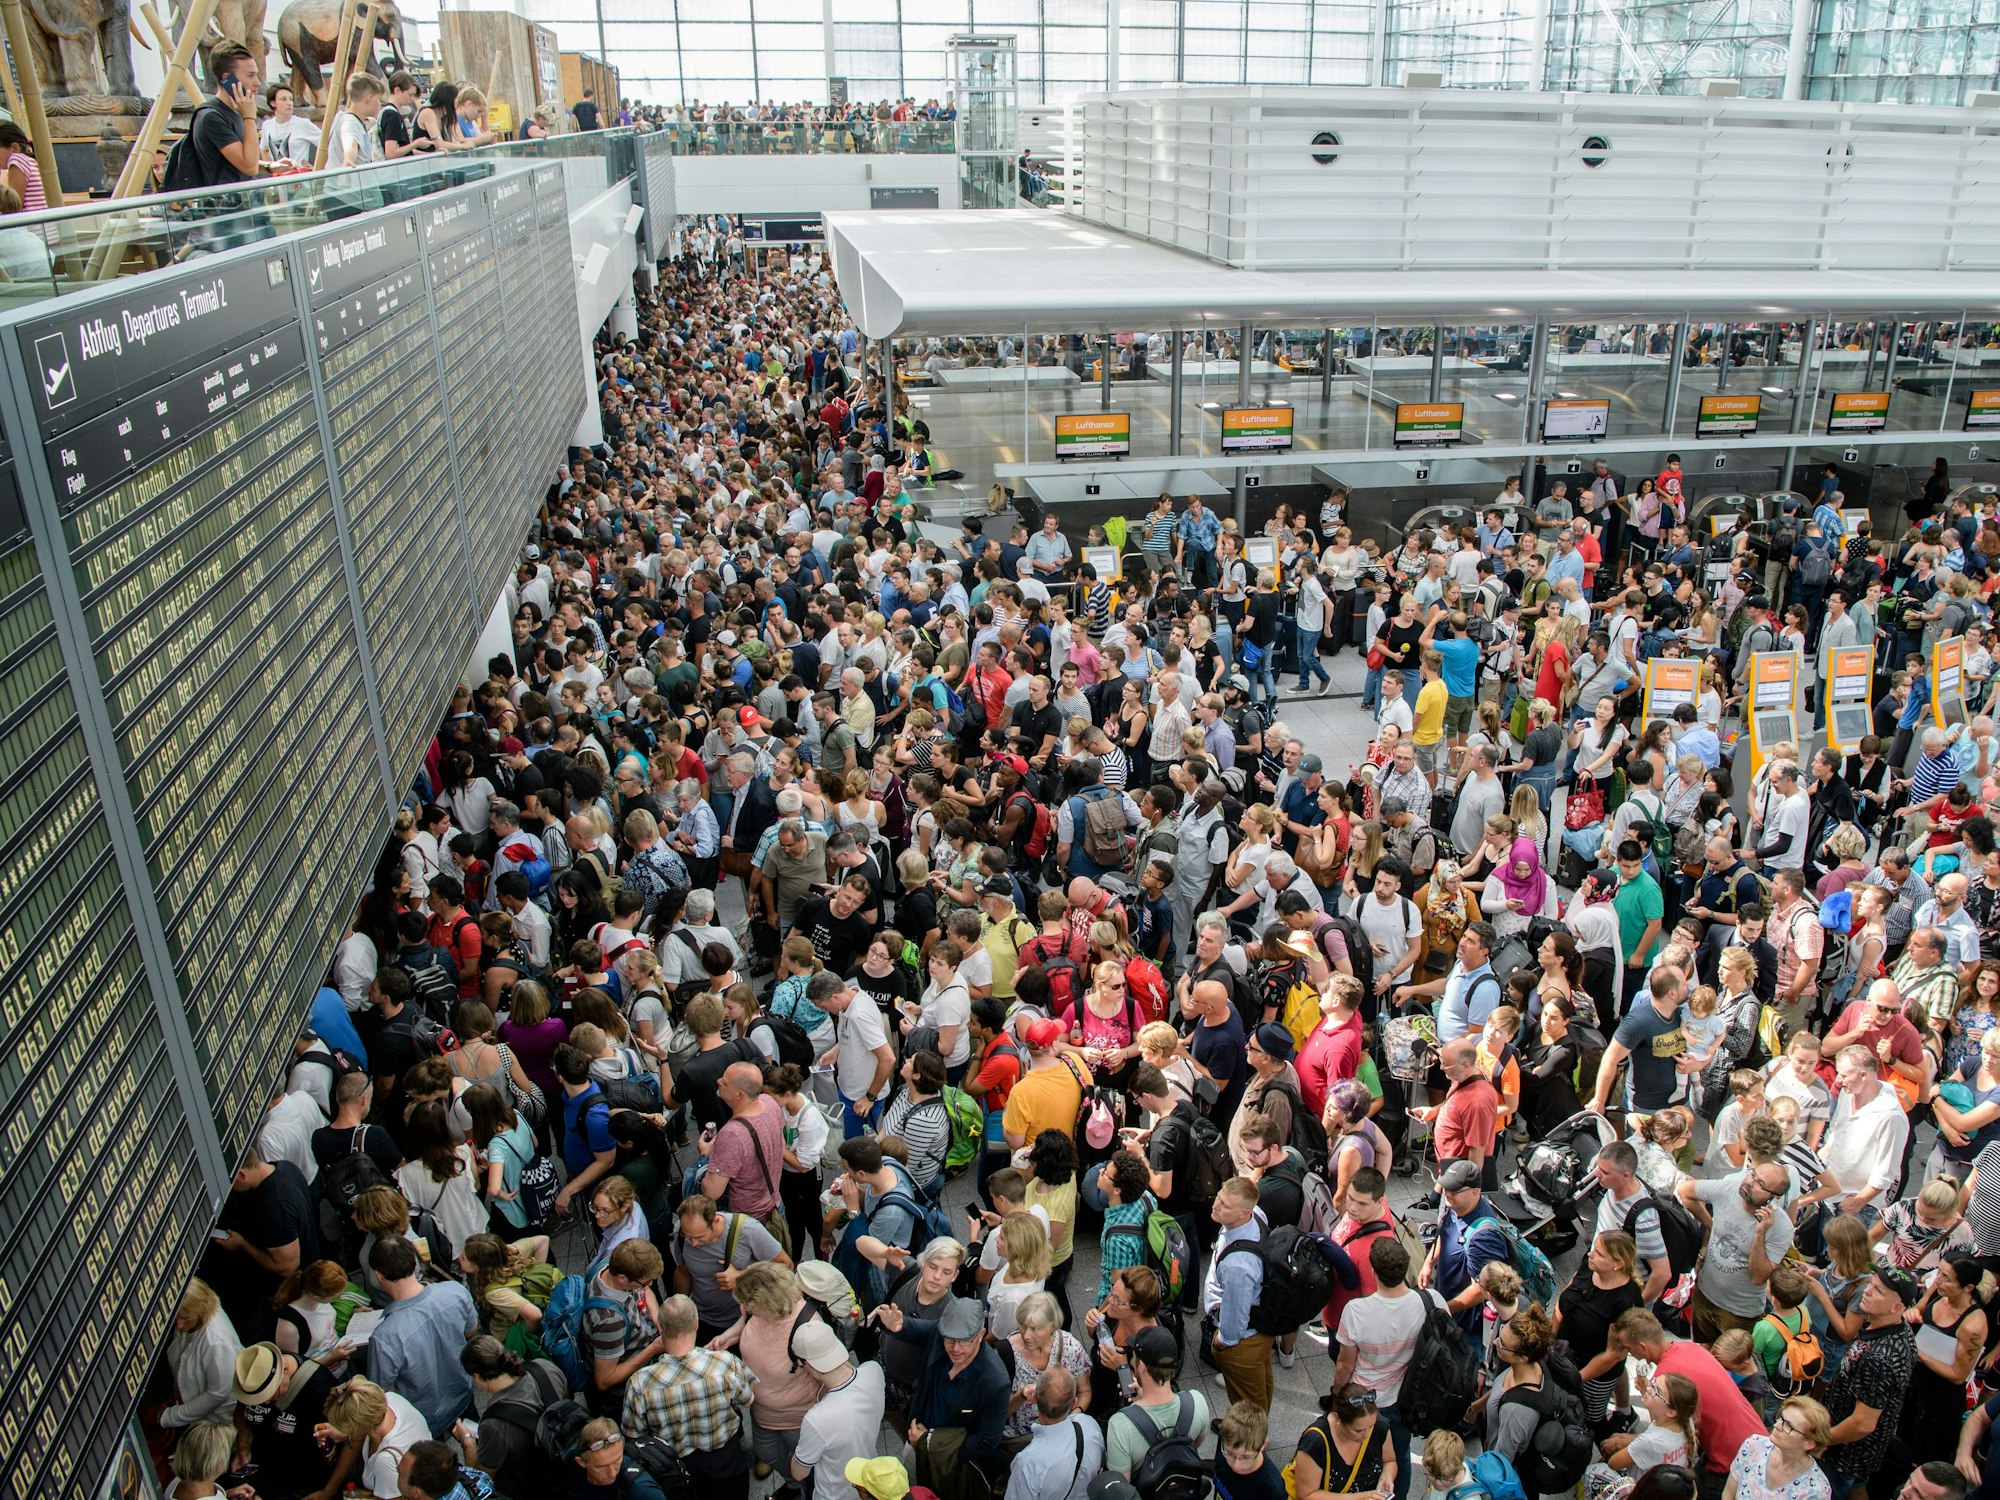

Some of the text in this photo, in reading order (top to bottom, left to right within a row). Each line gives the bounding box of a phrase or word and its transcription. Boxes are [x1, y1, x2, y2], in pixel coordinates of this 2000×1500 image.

[79, 278, 228, 360] Abflug Departures Terminal 2
[250, 352, 260, 366] Gate
[118, 416, 133, 437] nach
[155, 399, 168, 416] über
[161, 424, 171, 440] via
[207, 379, 250, 413] scheduled estimated
[1076, 422, 1114, 430] Lufthansa
[61, 448, 78, 467] Flug
[67, 473, 87, 495] Flight
[75, 510, 94, 544] LH
[95, 491, 125, 531] 2472
[130, 464, 168, 508] London
[212, 421, 237, 454] 08:40
[271, 383, 298, 416] delayed
[85, 554, 105, 589] LH
[105, 534, 134, 575] 2452
[139, 511, 167, 550] Oslo
[220, 456, 244, 491] 08:40
[278, 414, 303, 448] delayed
[123, 449, 132, 462] to
[96, 598, 115, 633] LH
[115, 575, 144, 617] 1784
[148, 543, 185, 591] Ankara
[227, 490, 251, 526] 08:50
[107, 641, 125, 676] LH
[125, 616, 153, 659] 1962
[157, 554, 224, 630] Lamezia-Terme
[234, 524, 257, 561] 08:55
[289, 475, 314, 511] delayed
[117, 683, 135, 718] LH
[135, 656, 162, 700] 1810
[166, 606, 214, 669] Barcelona
[241, 558, 264, 595] 09:00
[295, 504, 319, 541] delayed
[127, 533, 325, 759] LH 2034 Berlin 09:00 delayed
[137, 561, 330, 799] LH 1964 Catania 09:00 delayed
[147, 590, 335, 838] LH 1758 Heraklion 09:00 delayed
[173, 618, 341, 857] 9732 Luxembourg 09:00 delayed
[167, 878, 183, 915] LO
[182, 844, 207, 893] 8166
[210, 790, 244, 854] Tallinn
[276, 716, 296, 759] 09:10
[177, 674, 351, 953] EN 8218 Bari 09:15 delayed
[36, 900, 91, 987] delayed
[50, 943, 102, 1031] delayed
[61, 972, 128, 1075] Lufthansa
[195, 987, 210, 1024] LH
[205, 1022, 219, 1058] UA
[45, 1024, 126, 1163] K12 delayed
[89, 1064, 138, 1157] delayed
[214, 1056, 228, 1092] LH
[223, 1089, 237, 1125] UA
[101, 1103, 149, 1197] delayed
[232, 1121, 245, 1158] LH
[114, 1141, 159, 1236] delayed
[11, 1404, 59, 1496] 08:30
[60, 1320, 101, 1405] 11:00
[124, 1161, 181, 1274] Lufthansa
[112, 1212, 182, 1362] K01 delayed
[150, 1247, 190, 1347] delayed
